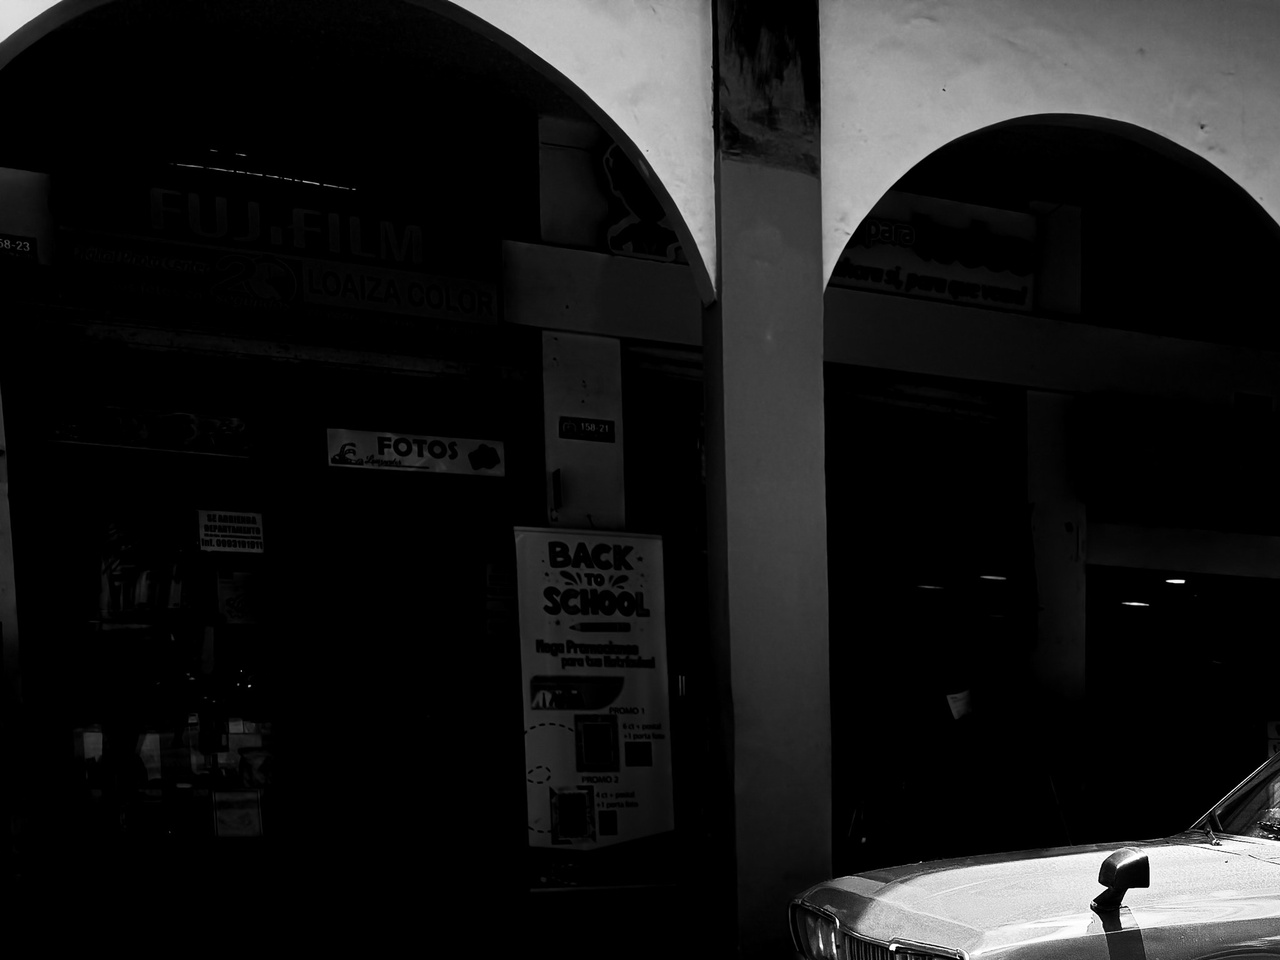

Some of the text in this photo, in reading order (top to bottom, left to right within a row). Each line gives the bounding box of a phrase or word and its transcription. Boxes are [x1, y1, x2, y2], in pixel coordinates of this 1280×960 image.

[866, 218, 916, 247] para
[307, 267, 495, 318] LOAIZA COLOR
[376, 436, 459, 461] FOTOS
[548, 541, 634, 571] BACK
[584, 573, 605, 587] TO
[543, 586, 651, 617] SCHOOL
[561, 657, 584, 669] para
[609, 706, 640, 715] PROMO
[581, 775, 612, 784] PROMO
